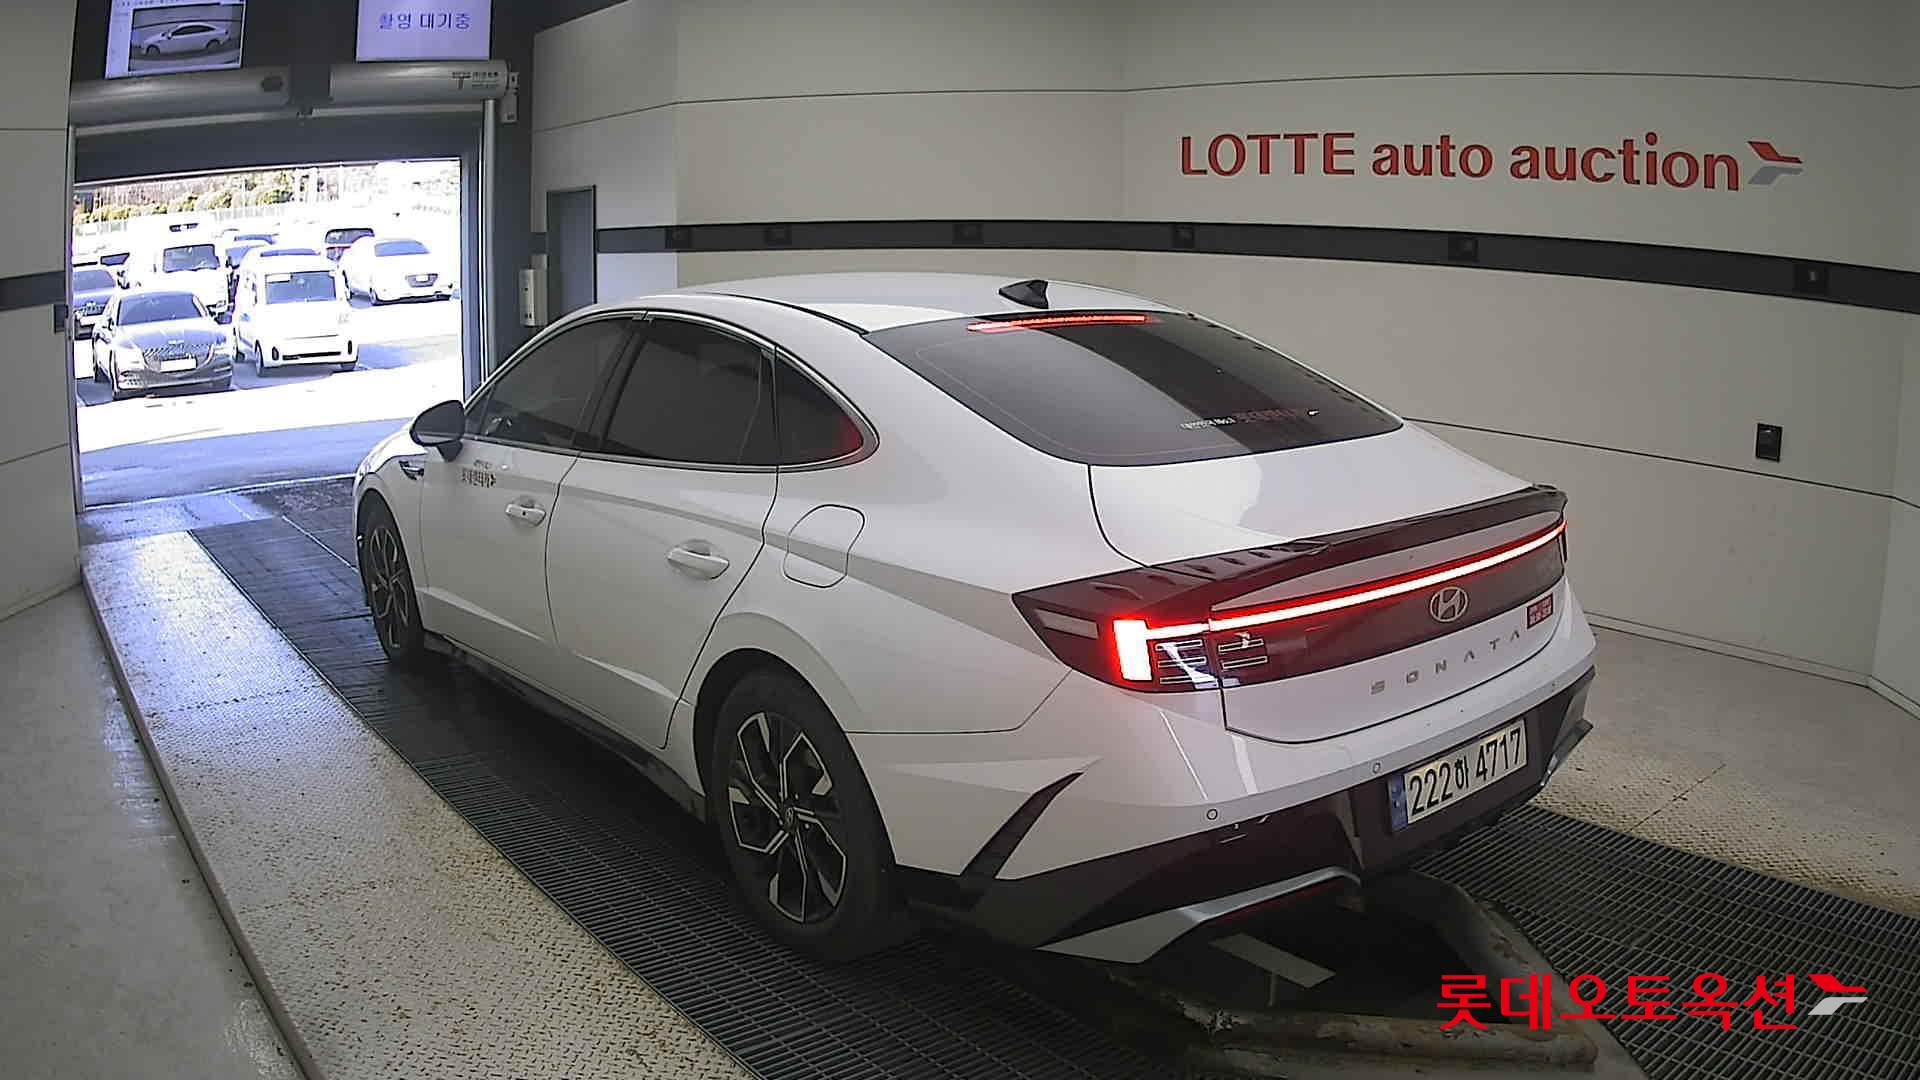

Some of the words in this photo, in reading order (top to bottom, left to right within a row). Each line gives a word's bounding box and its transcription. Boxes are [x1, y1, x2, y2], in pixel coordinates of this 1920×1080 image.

[420, 12, 470, 30] 대기중
[1181, 131, 1356, 177] LOTTE
[1371, 134, 1493, 178] auto
[1510, 131, 1741, 192] auction
[1370, 629, 1521, 695] SONATA
[1475, 727, 1521, 782] 4717
